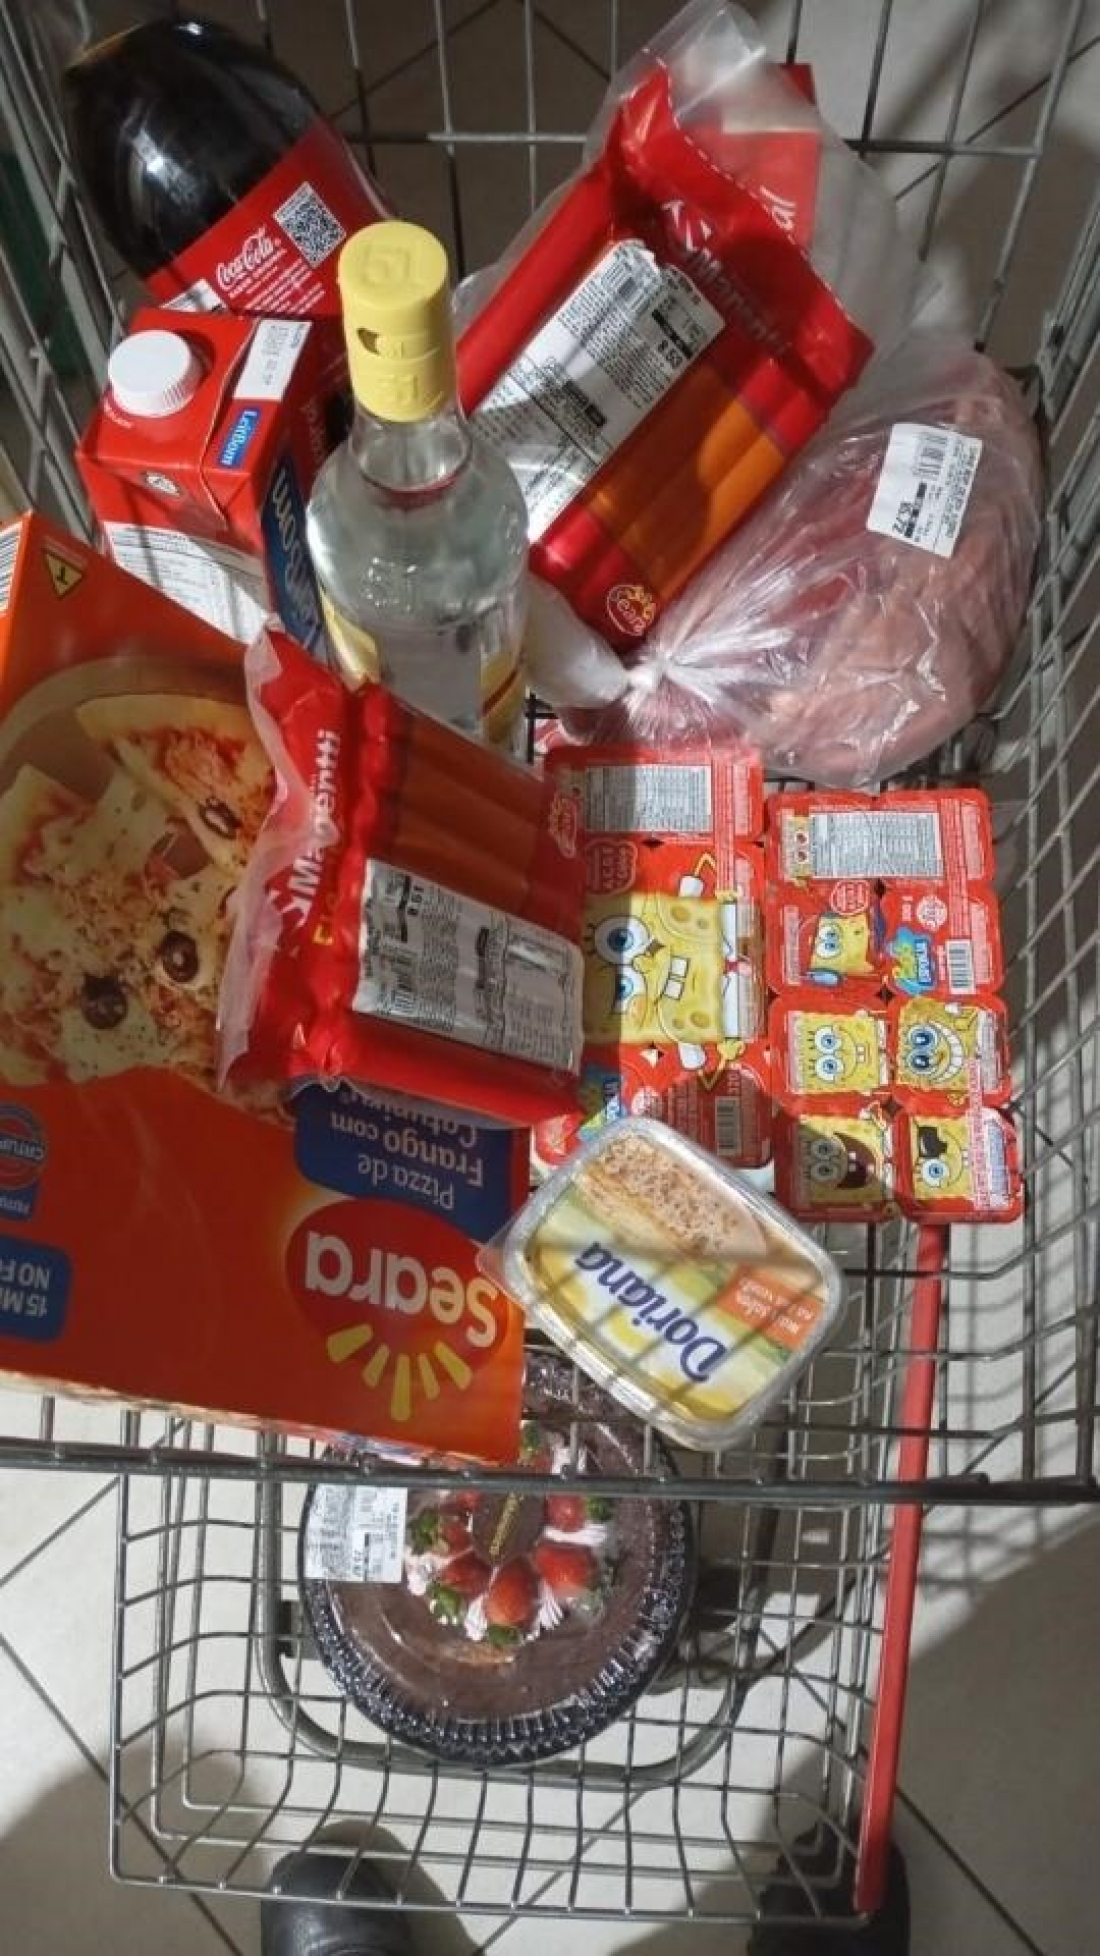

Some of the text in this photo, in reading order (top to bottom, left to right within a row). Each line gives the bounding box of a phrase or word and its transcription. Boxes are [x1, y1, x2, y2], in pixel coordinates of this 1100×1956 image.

[330, 1110, 485, 1188] Frango com
[357, 1153, 456, 1211] Pizza de
[18, 1262, 50, 1291] NO
[27, 1295, 48, 1317] 15
[304, 1231, 499, 1348] Seara
[574, 1241, 727, 1383] Doriana
